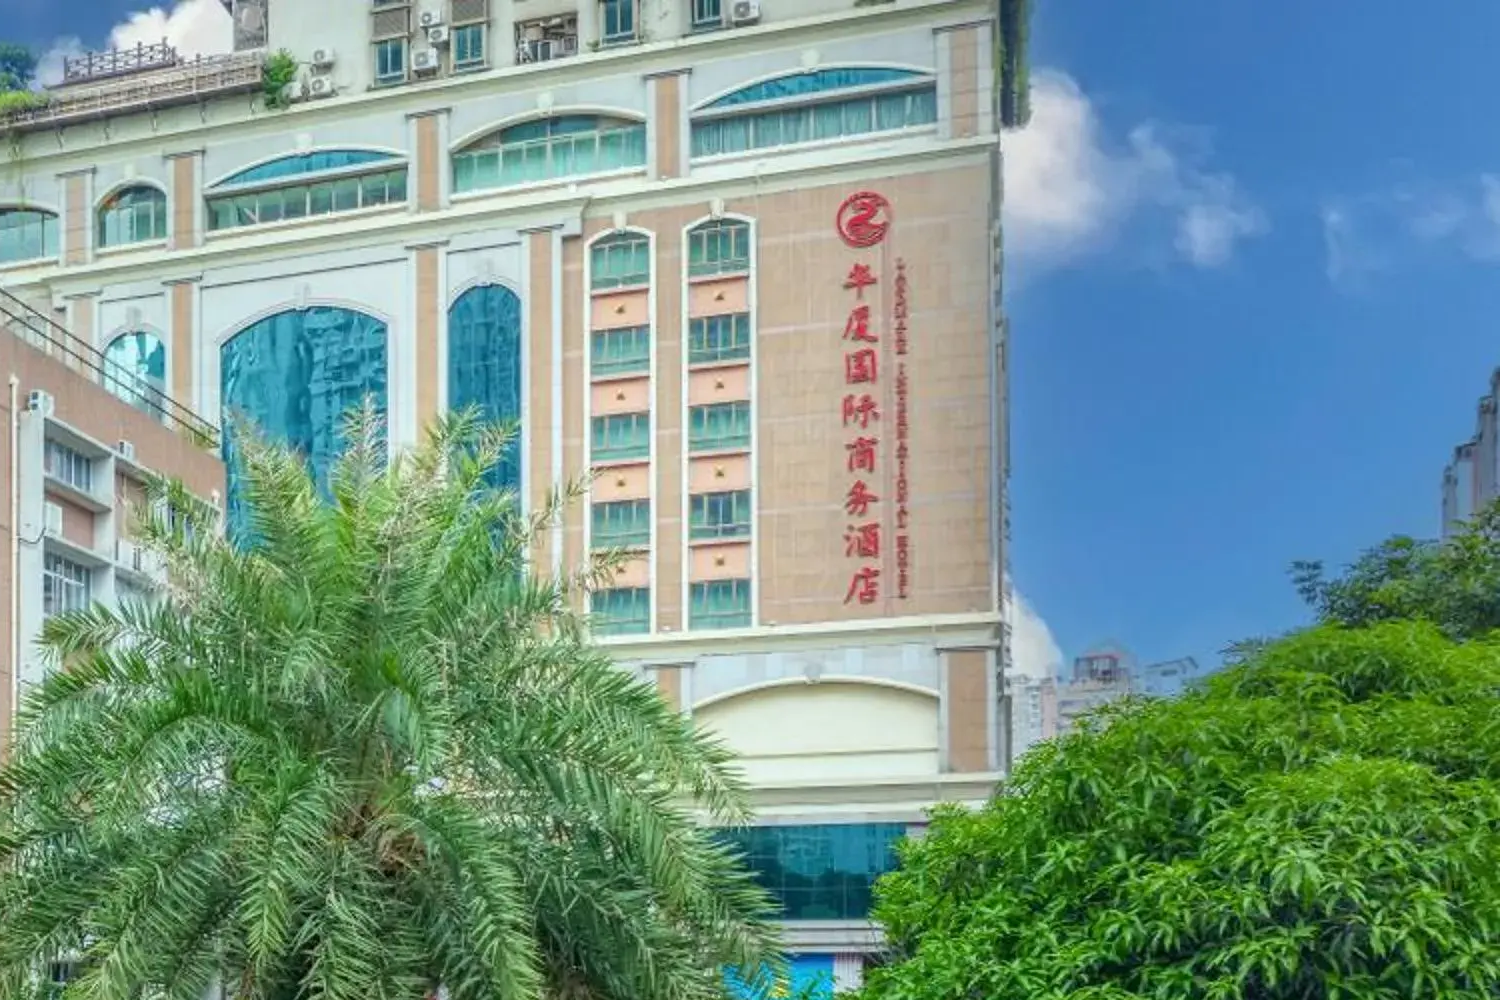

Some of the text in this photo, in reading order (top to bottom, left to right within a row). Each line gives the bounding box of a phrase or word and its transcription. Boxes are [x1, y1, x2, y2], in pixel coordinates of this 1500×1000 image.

[842, 262, 880, 605] 华厦国际商务酒店
